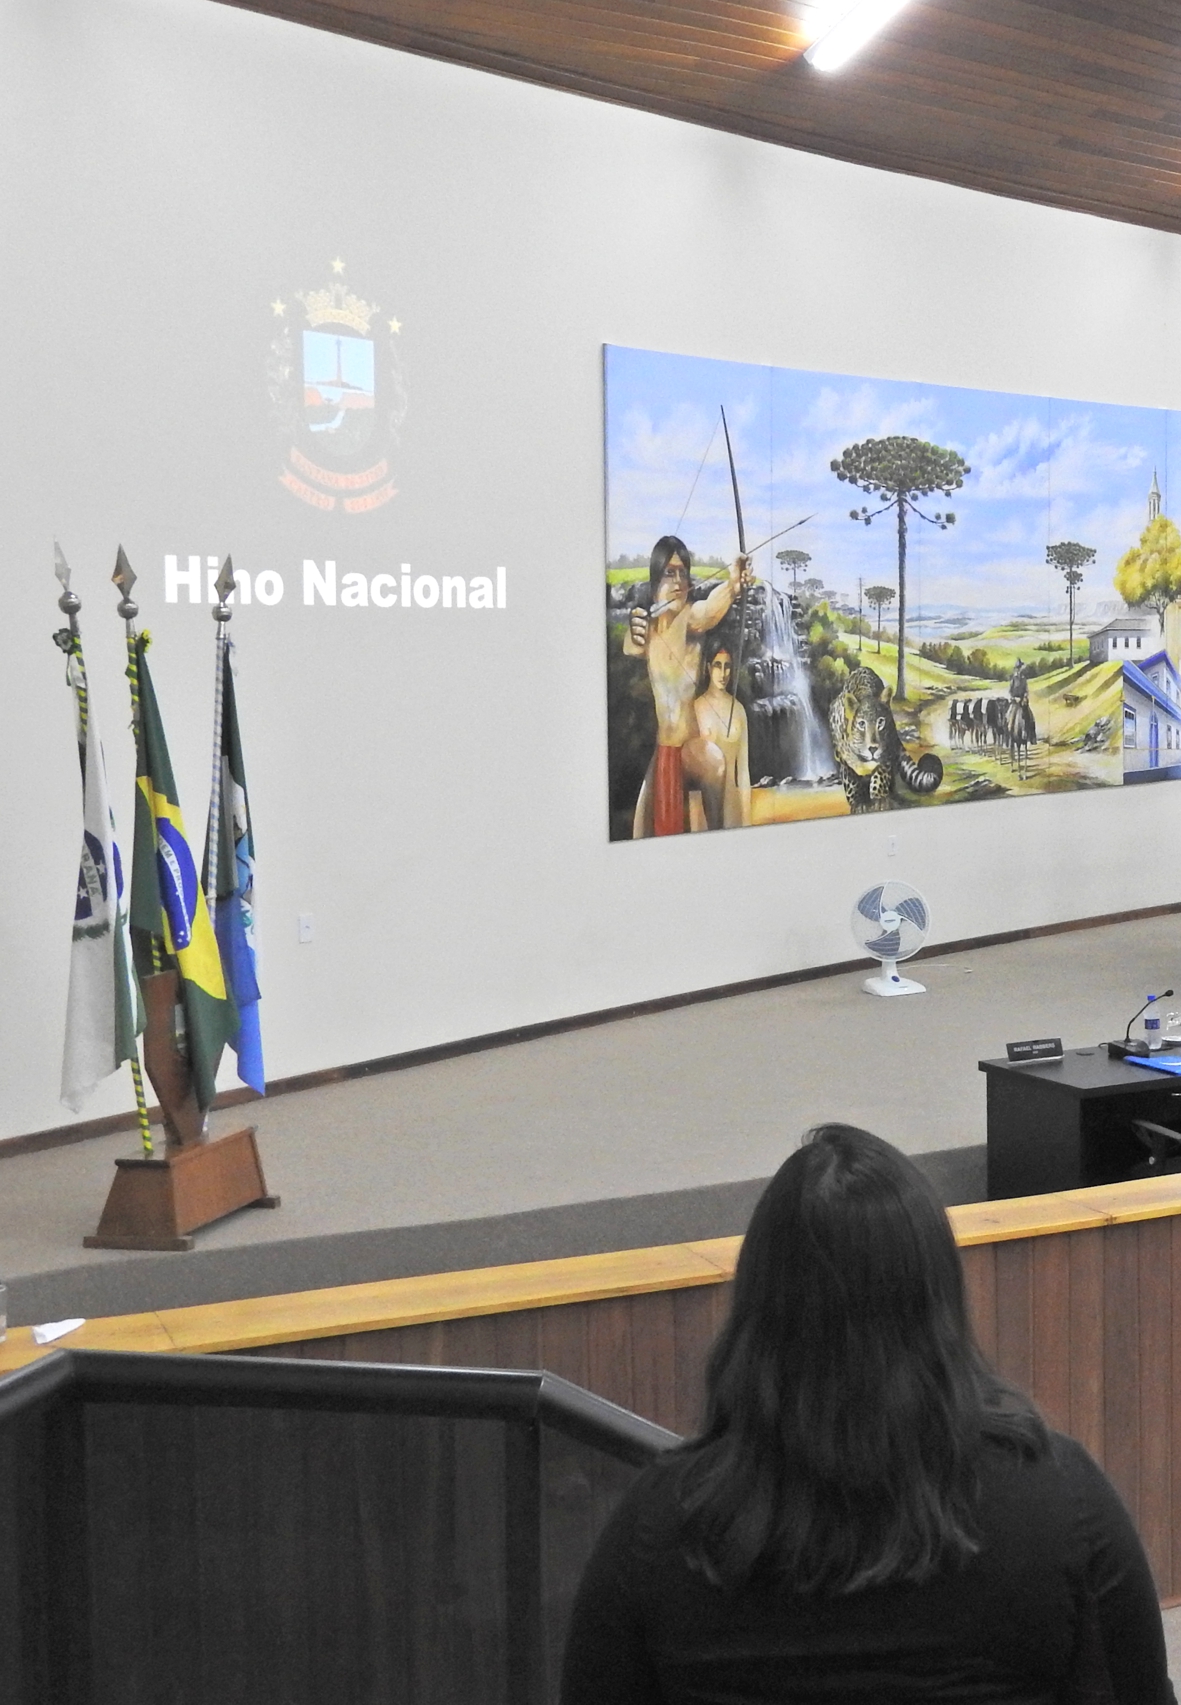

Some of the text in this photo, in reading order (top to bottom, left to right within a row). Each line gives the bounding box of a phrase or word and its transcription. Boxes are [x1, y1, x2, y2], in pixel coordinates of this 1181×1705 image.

[164, 554, 507, 609] Hino Nacional
[81, 853, 102, 896] RANÁ
